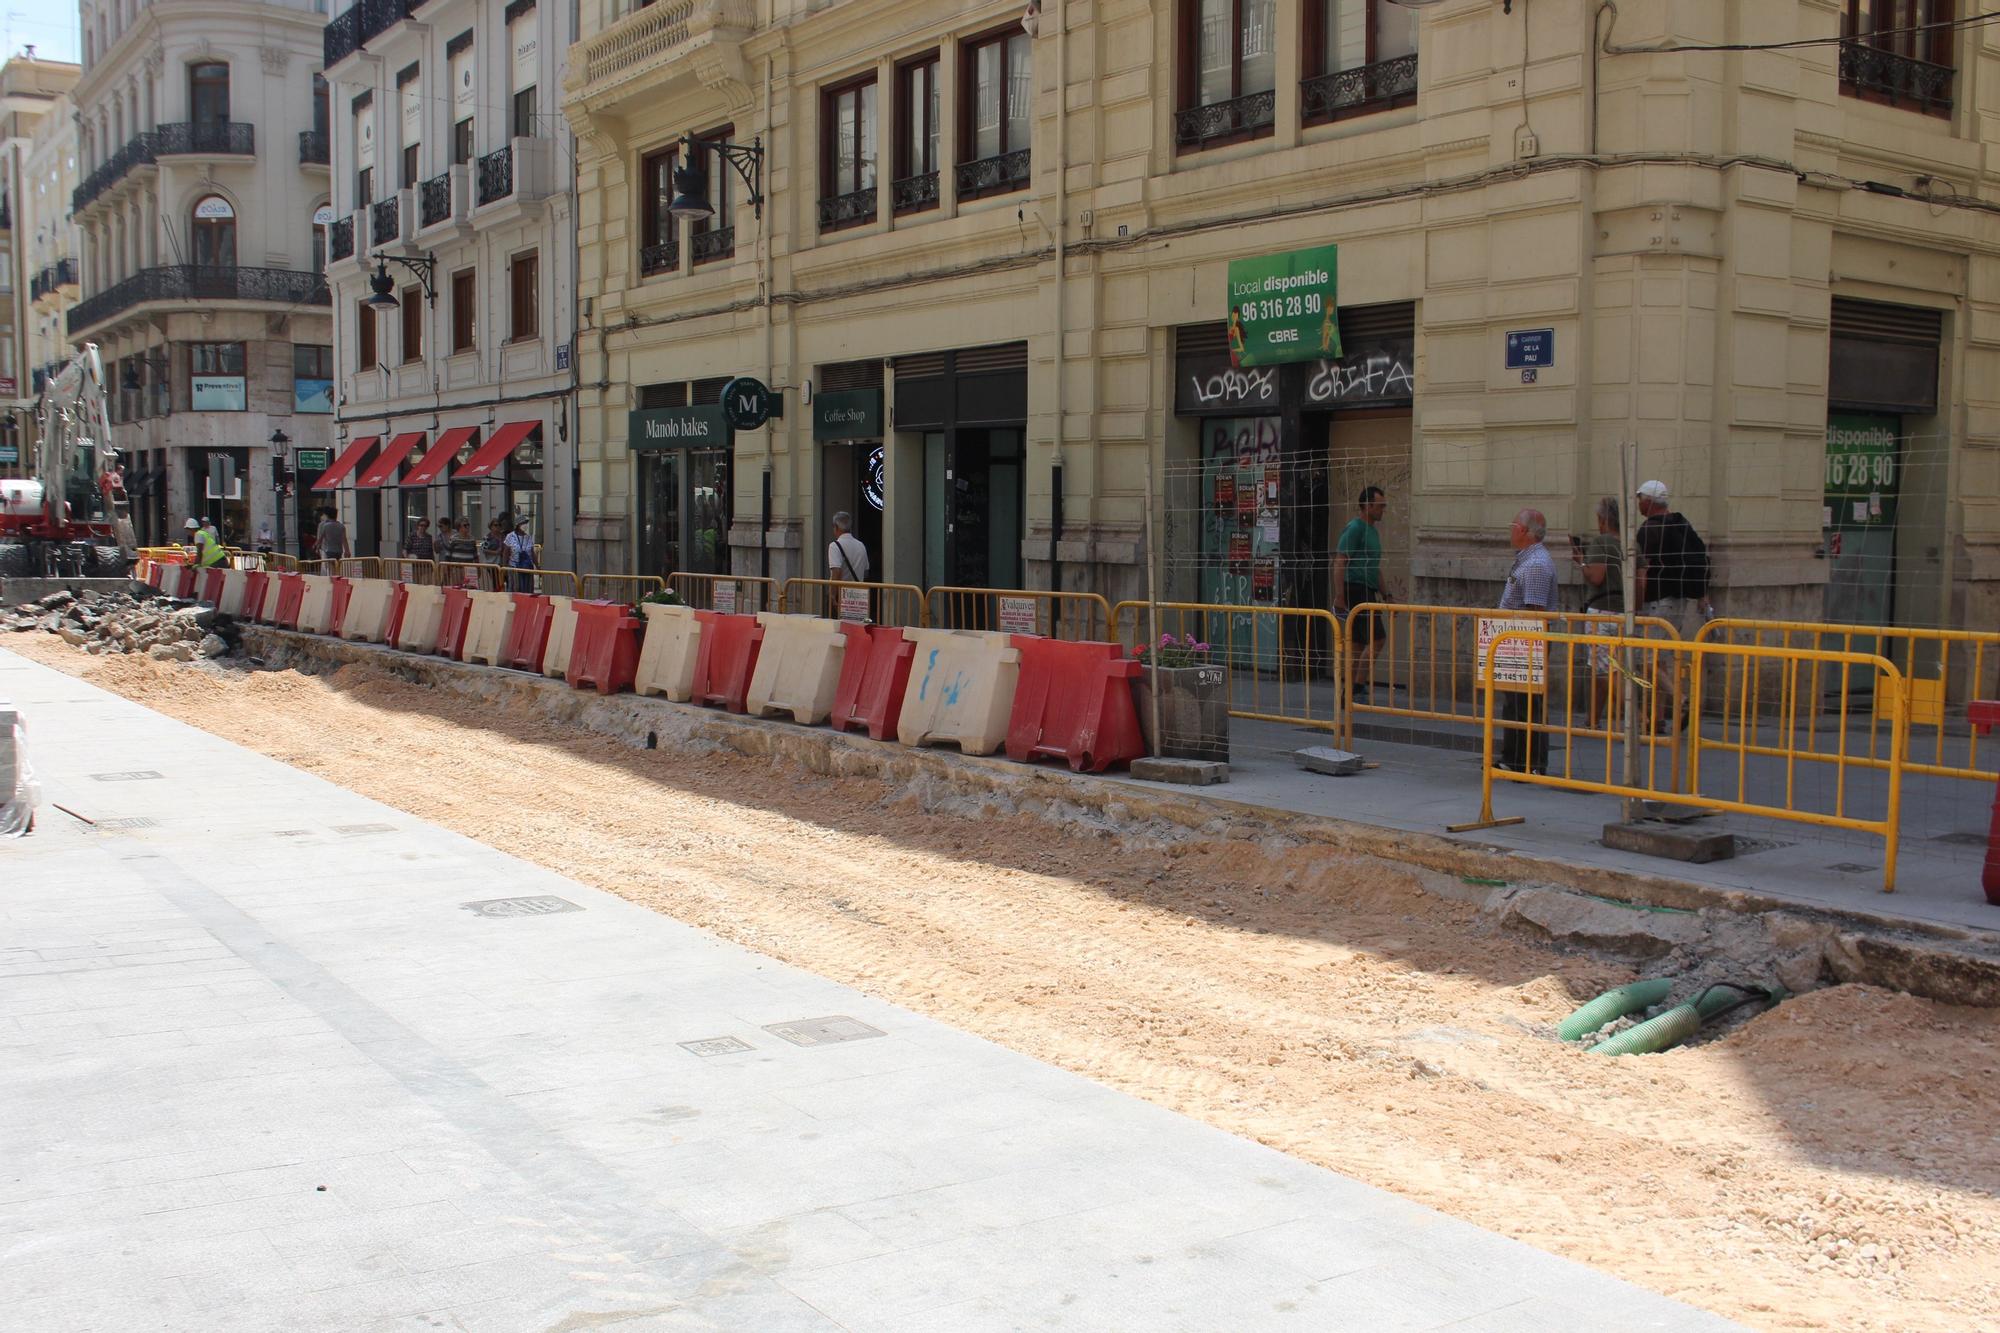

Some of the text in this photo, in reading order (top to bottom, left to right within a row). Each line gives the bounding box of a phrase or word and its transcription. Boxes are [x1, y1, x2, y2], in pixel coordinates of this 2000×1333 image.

[1234, 269, 1328, 296] Local disponible
[1242, 293, 1321, 322] 96 316 28 90
[1268, 328, 1299, 343] CBRE
[1524, 354, 1537, 362] PAU
[739, 394, 758, 414] M
[824, 408, 866, 423] Coffee Shop
[646, 416, 708, 439] Manolo bakes
[1848, 454, 1868, 485] 28
[1873, 455, 1893, 486] 90
[1520, 639, 1543, 647] VETA
